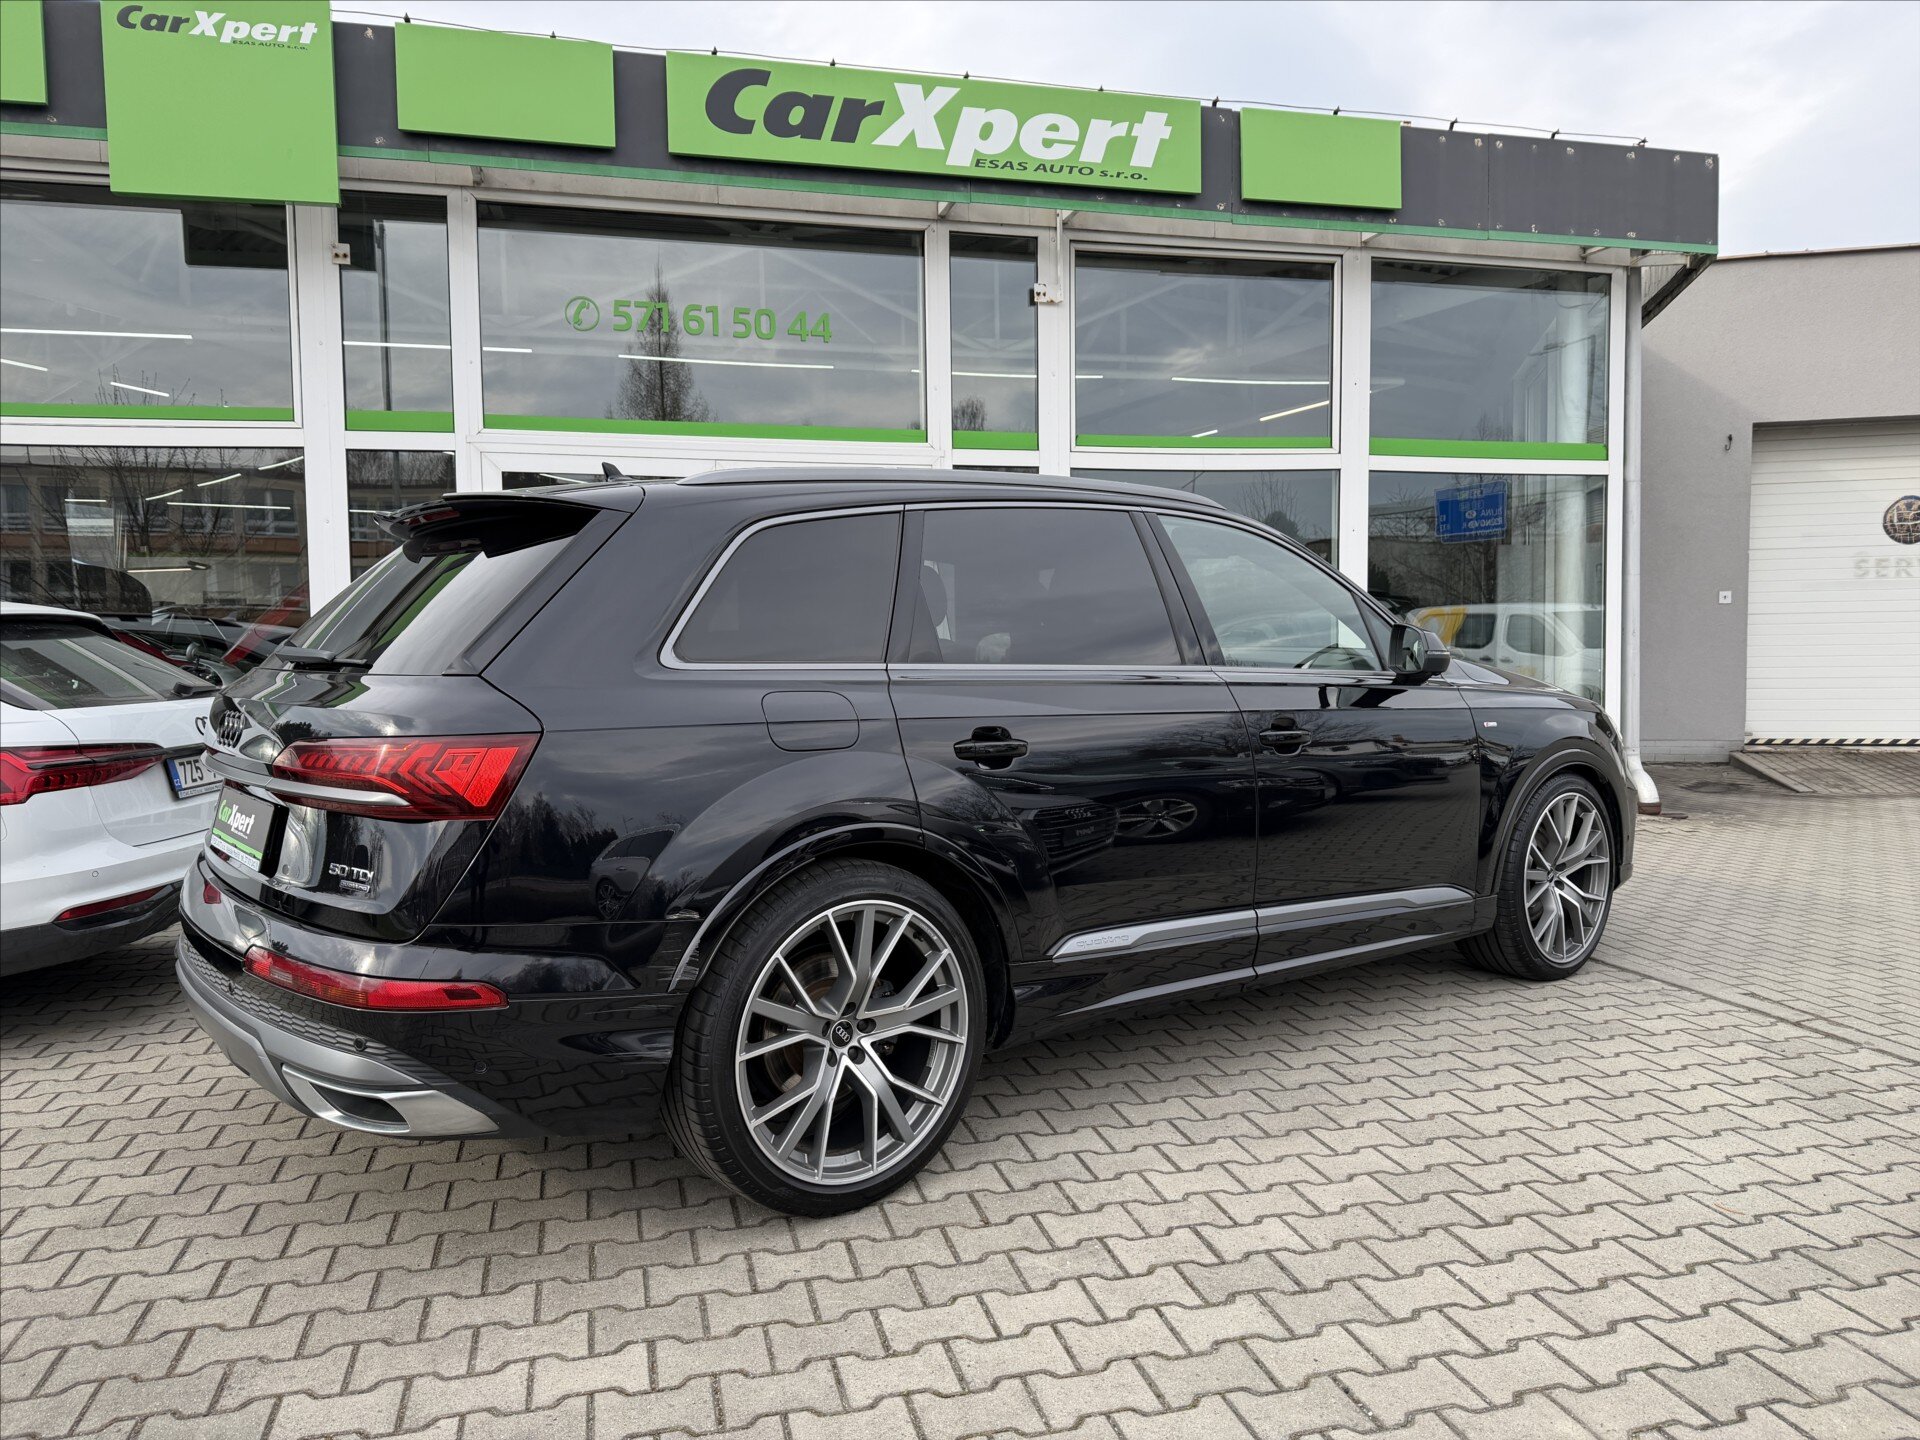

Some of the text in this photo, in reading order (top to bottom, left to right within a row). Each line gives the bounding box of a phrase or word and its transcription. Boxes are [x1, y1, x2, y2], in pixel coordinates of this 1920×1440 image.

[116, 4, 318, 44] CarXpert
[232, 39, 256, 47] ESAS
[258, 41, 285, 49] AUTO
[704, 67, 1173, 168] CarXpert
[974, 158, 1148, 182] ESAS AUTO s.r.o.
[613, 299, 833, 344] 571 61 50 44
[1853, 557, 1920, 578] SER
[328, 862, 375, 883] 50 TDI
[1075, 934, 1130, 949] quattro
